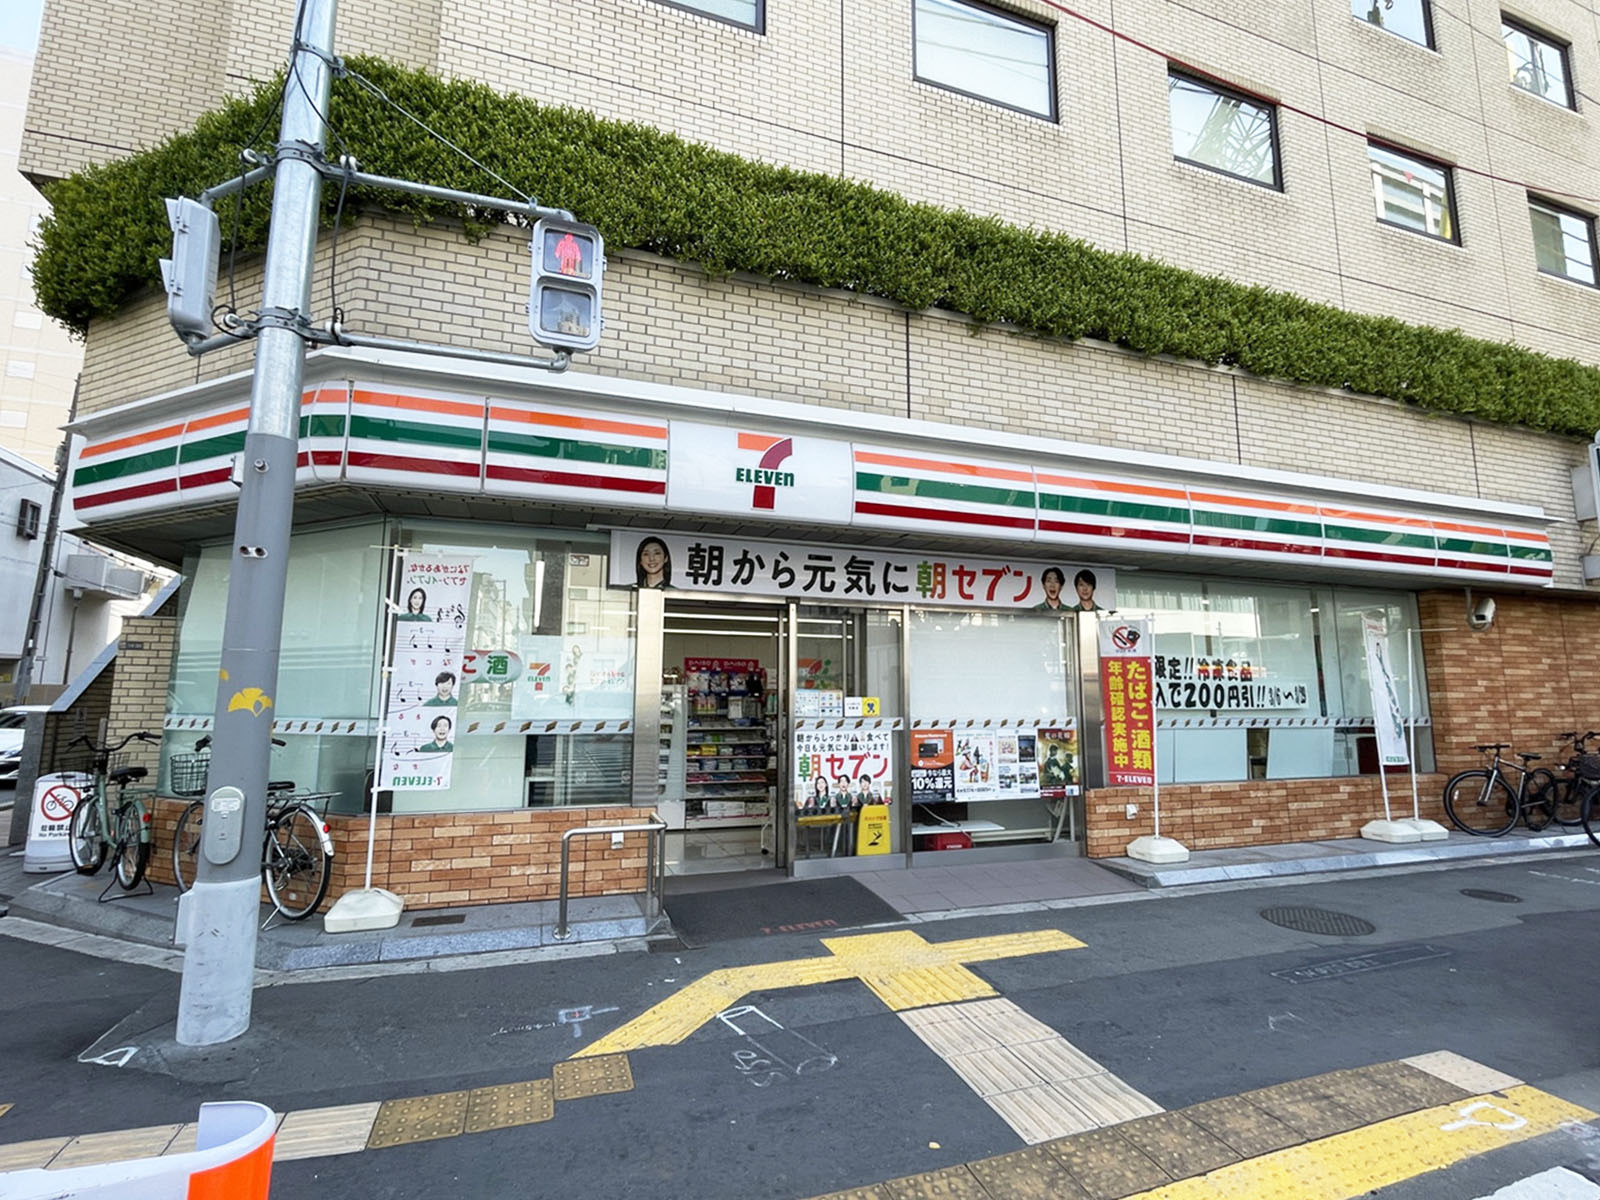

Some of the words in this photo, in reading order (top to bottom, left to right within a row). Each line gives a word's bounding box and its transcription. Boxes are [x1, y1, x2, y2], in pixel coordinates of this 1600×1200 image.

[684, 542, 1032, 603] 朝から元気に朝セブン
[487, 655, 509, 675] 酒
[1107, 660, 1129, 769] 年齢確認実施中
[1127, 661, 1152, 770] たばこ・酒類
[798, 752, 888, 782] 朝セブン
